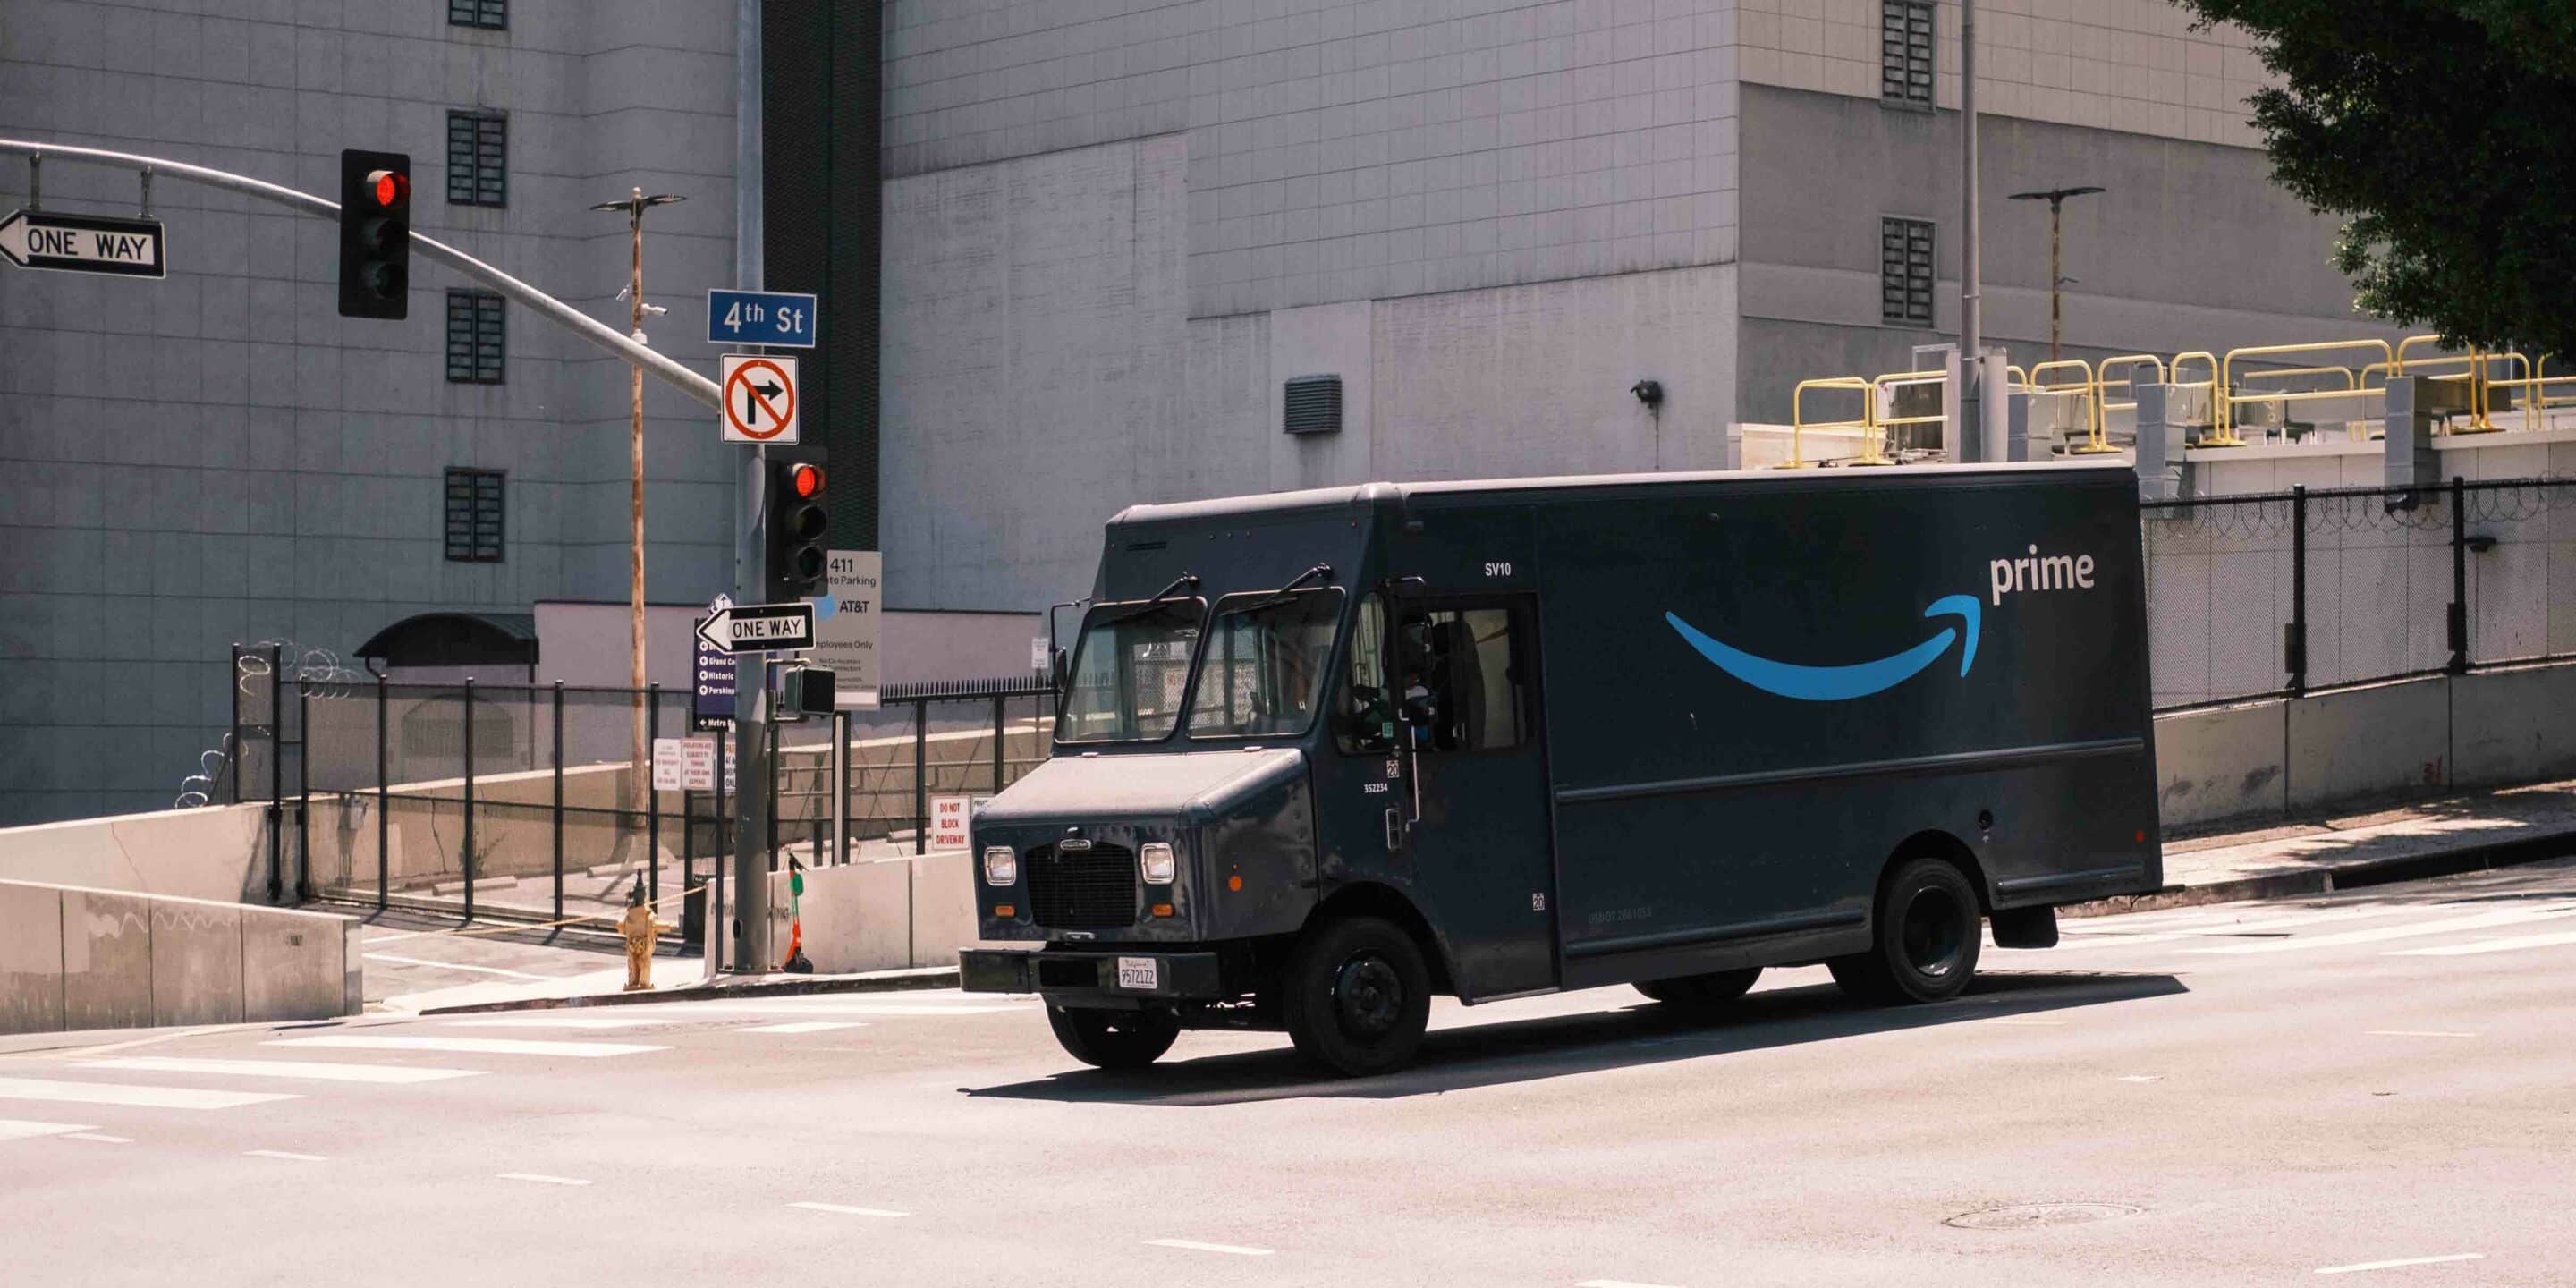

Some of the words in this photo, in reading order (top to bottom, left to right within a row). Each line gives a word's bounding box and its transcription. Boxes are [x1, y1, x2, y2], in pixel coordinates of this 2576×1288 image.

[28, 228, 78, 256] ONE
[95, 233, 147, 260] WAY
[723, 301, 764, 334] 4th
[775, 306, 803, 334] St
[830, 558, 853, 572] 411
[1485, 563, 1512, 576] SV10
[841, 575, 877, 588] Parking
[1990, 544, 2095, 606] prime
[839, 600, 870, 614] AT&T
[733, 622, 765, 638] ONE
[769, 619, 801, 636] WAY
[854, 640, 874, 650] Only
[708, 657, 726, 665] Grand
[708, 672, 734, 680] Historic
[708, 718, 726, 726] Metro
[939, 803, 949, 813] DO
[949, 803, 960, 813] NOT
[941, 819, 960, 829] BLOCK
[936, 835, 965, 845] DRIVEWAY
